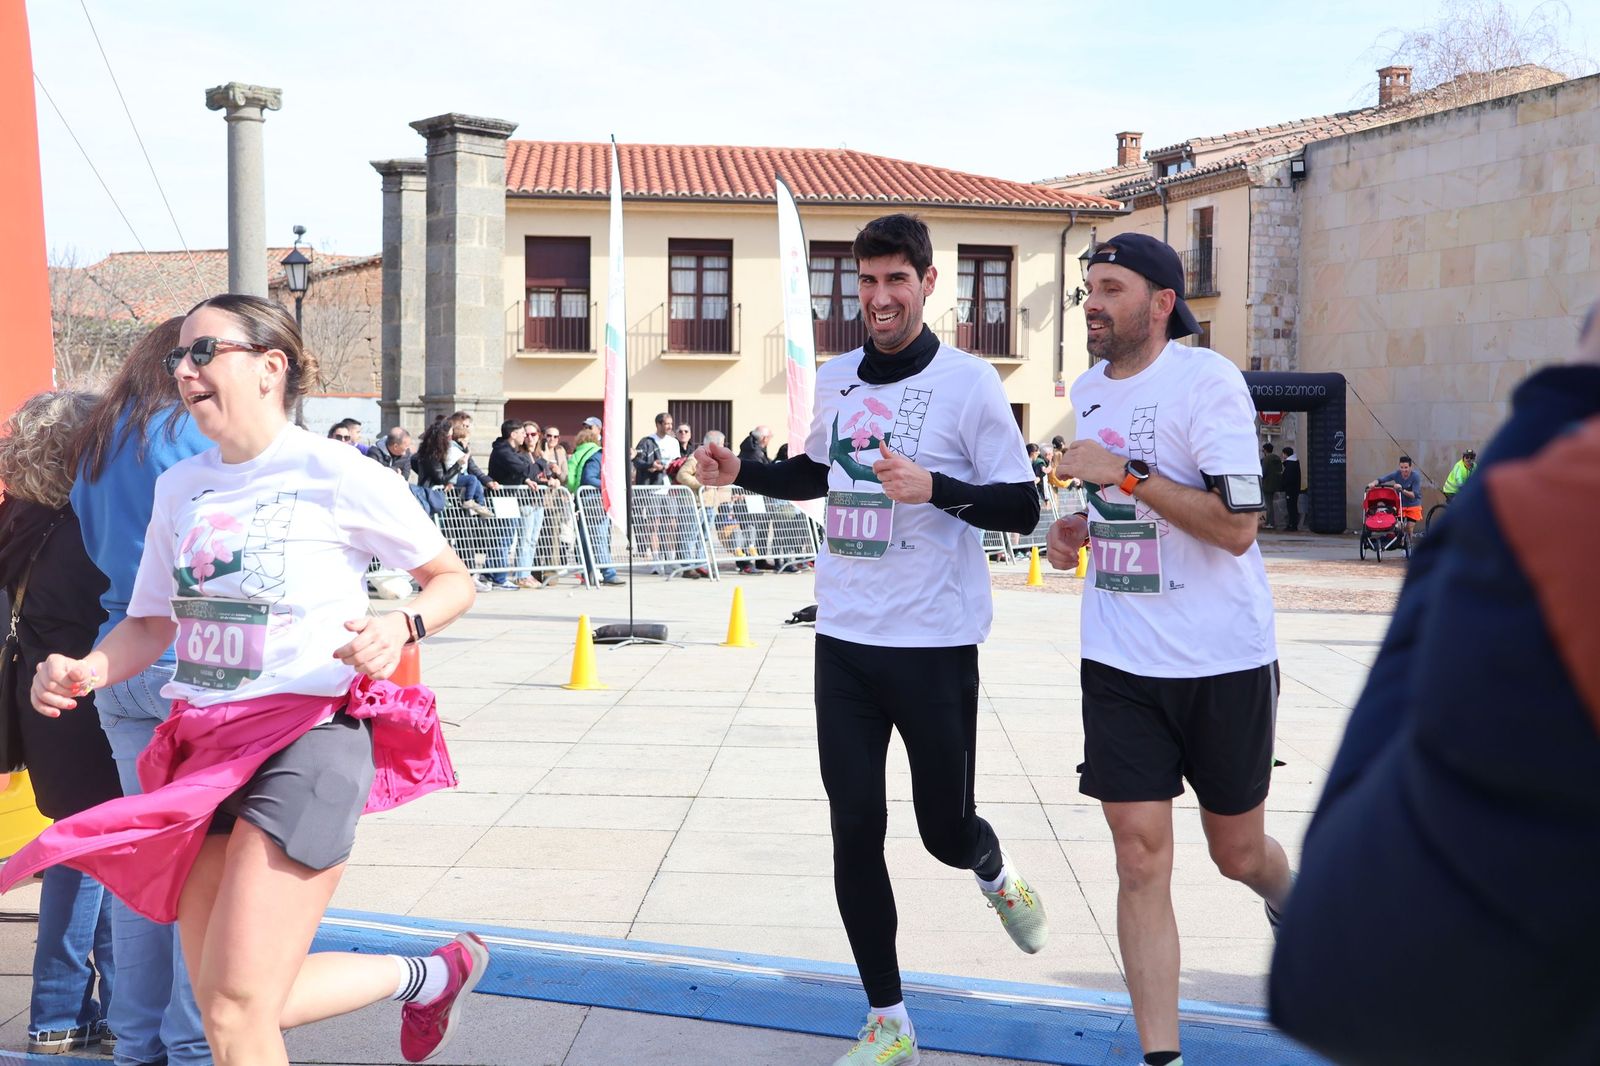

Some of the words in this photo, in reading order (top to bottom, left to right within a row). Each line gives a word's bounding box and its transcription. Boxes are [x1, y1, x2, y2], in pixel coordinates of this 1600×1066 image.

[1285, 385, 1326, 396] zamora
[836, 509, 877, 538] 710
[1098, 540, 1142, 572] 772
[188, 622, 244, 665] 620
